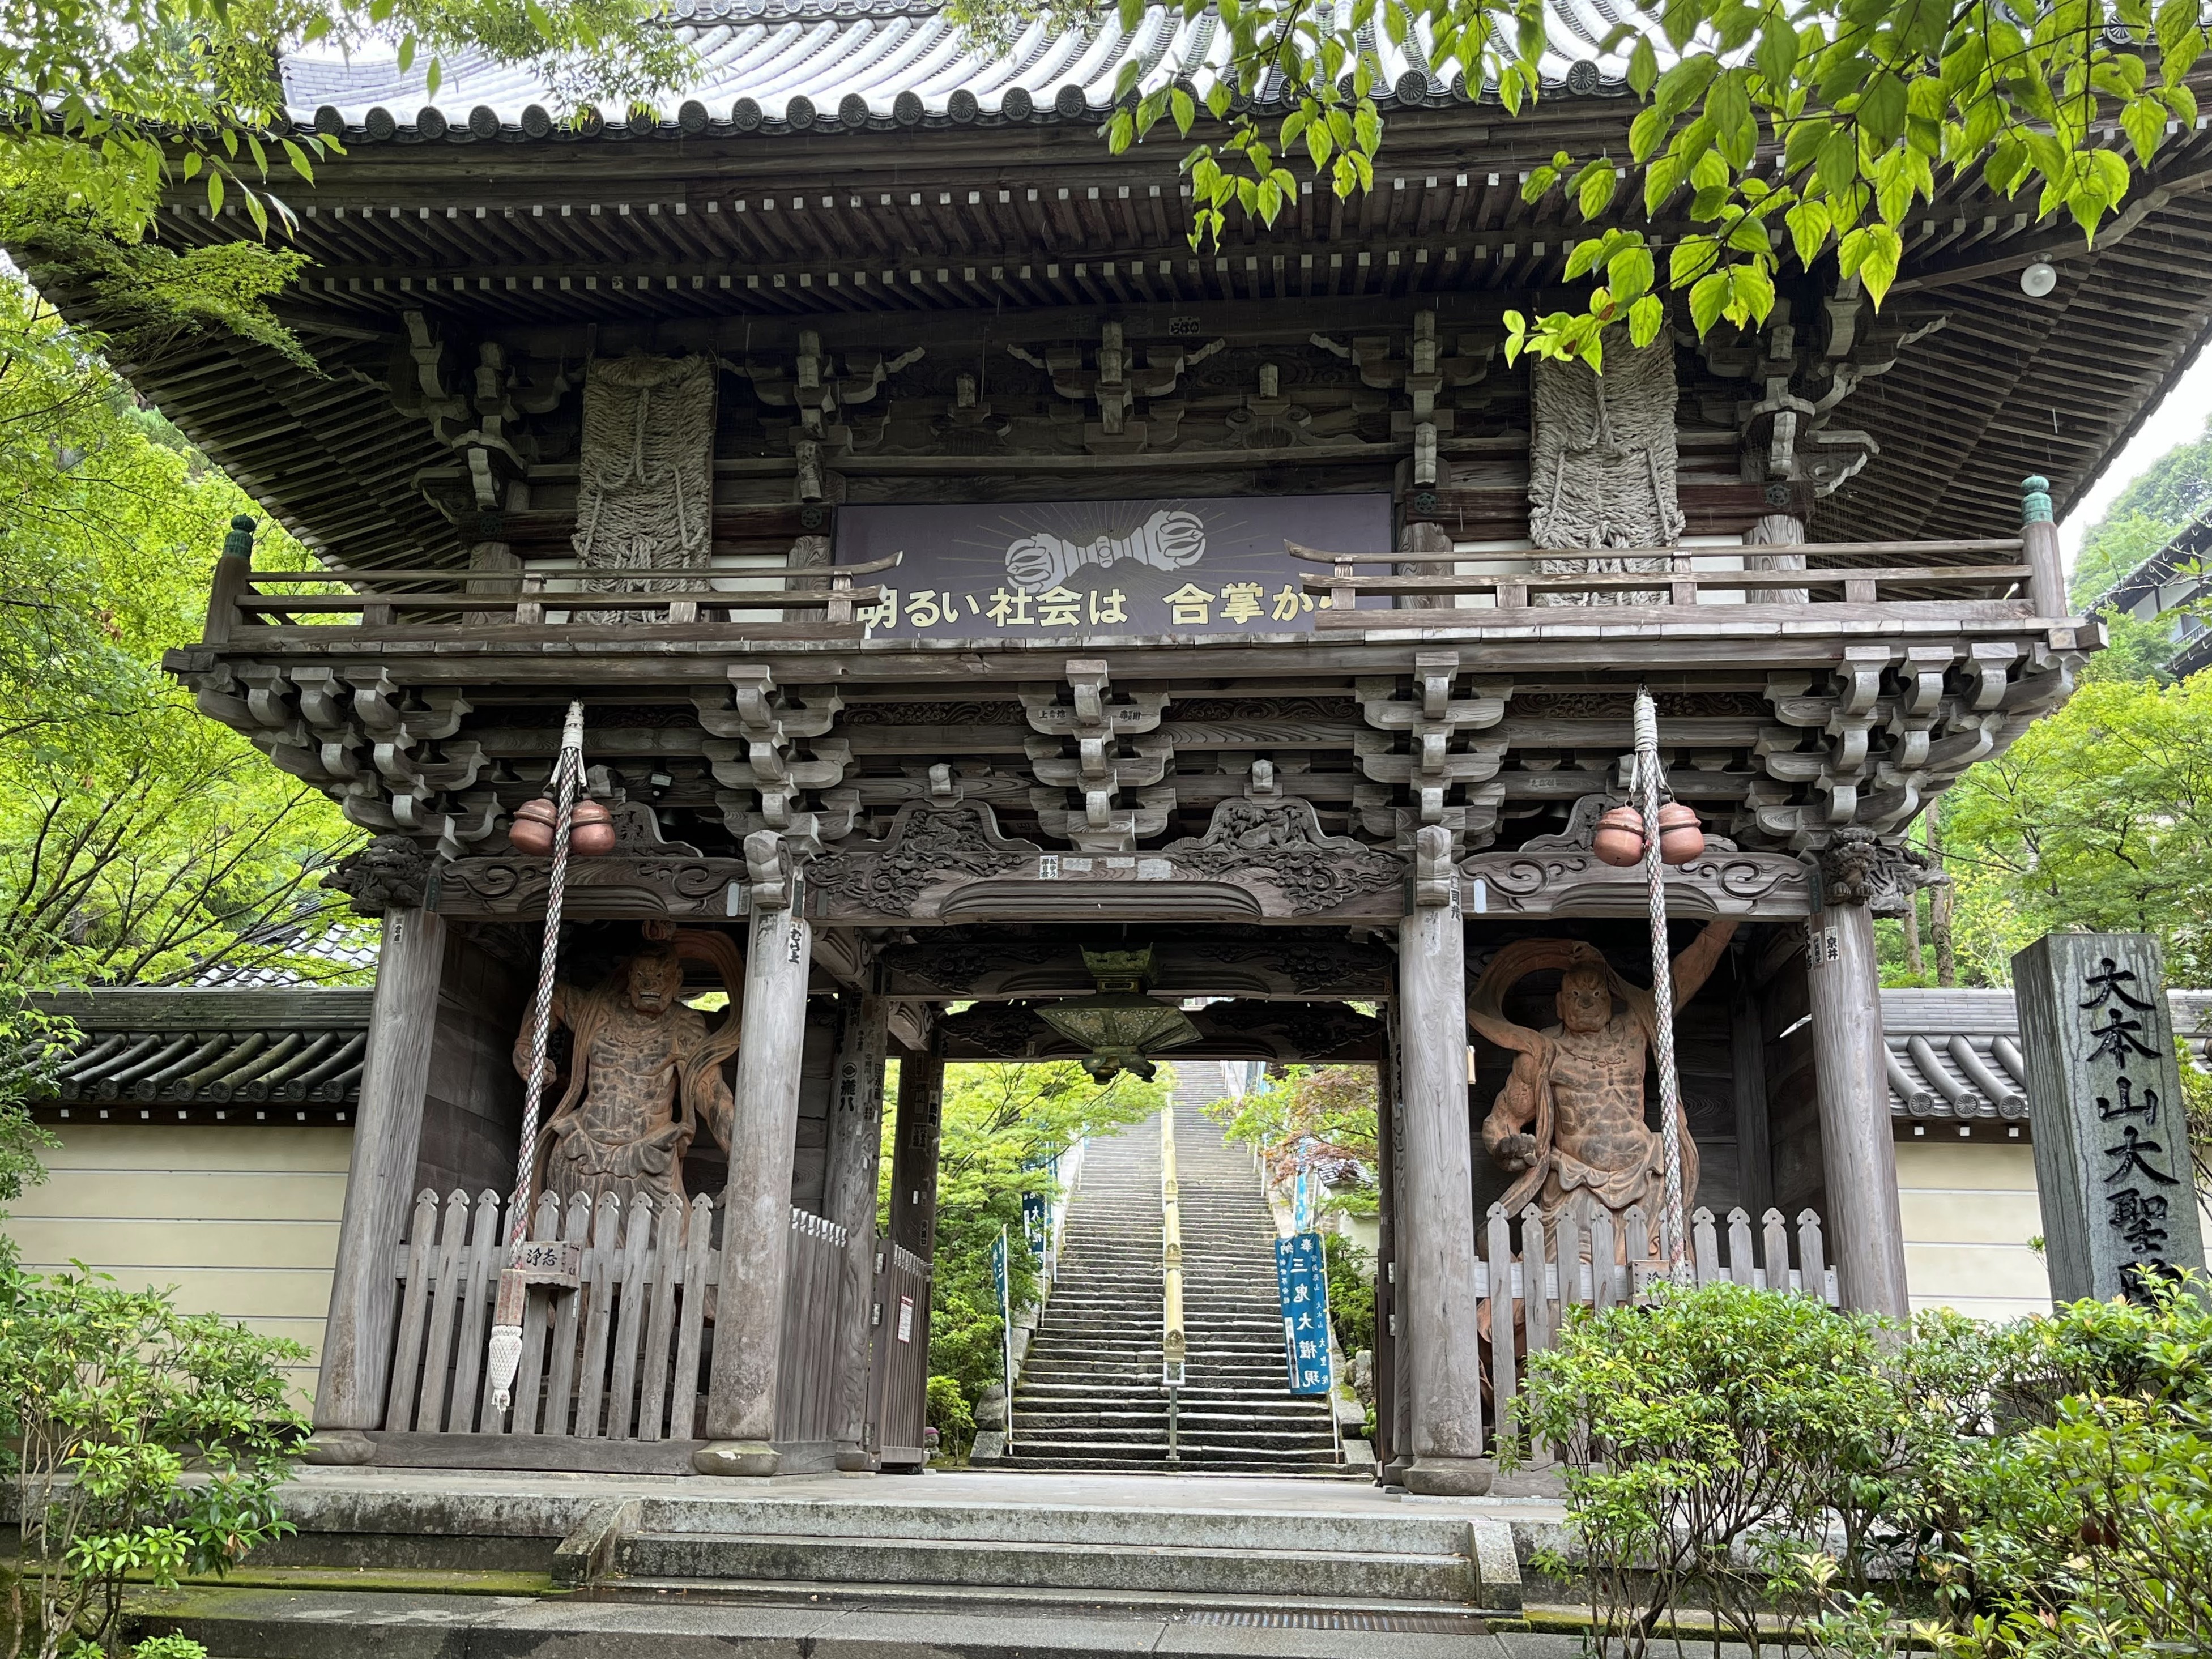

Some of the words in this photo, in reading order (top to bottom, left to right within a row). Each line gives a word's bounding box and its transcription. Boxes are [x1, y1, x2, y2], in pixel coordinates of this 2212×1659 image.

[856, 584, 1127, 629] 明るい社会は
[1162, 583, 1332, 627] 合掌か
